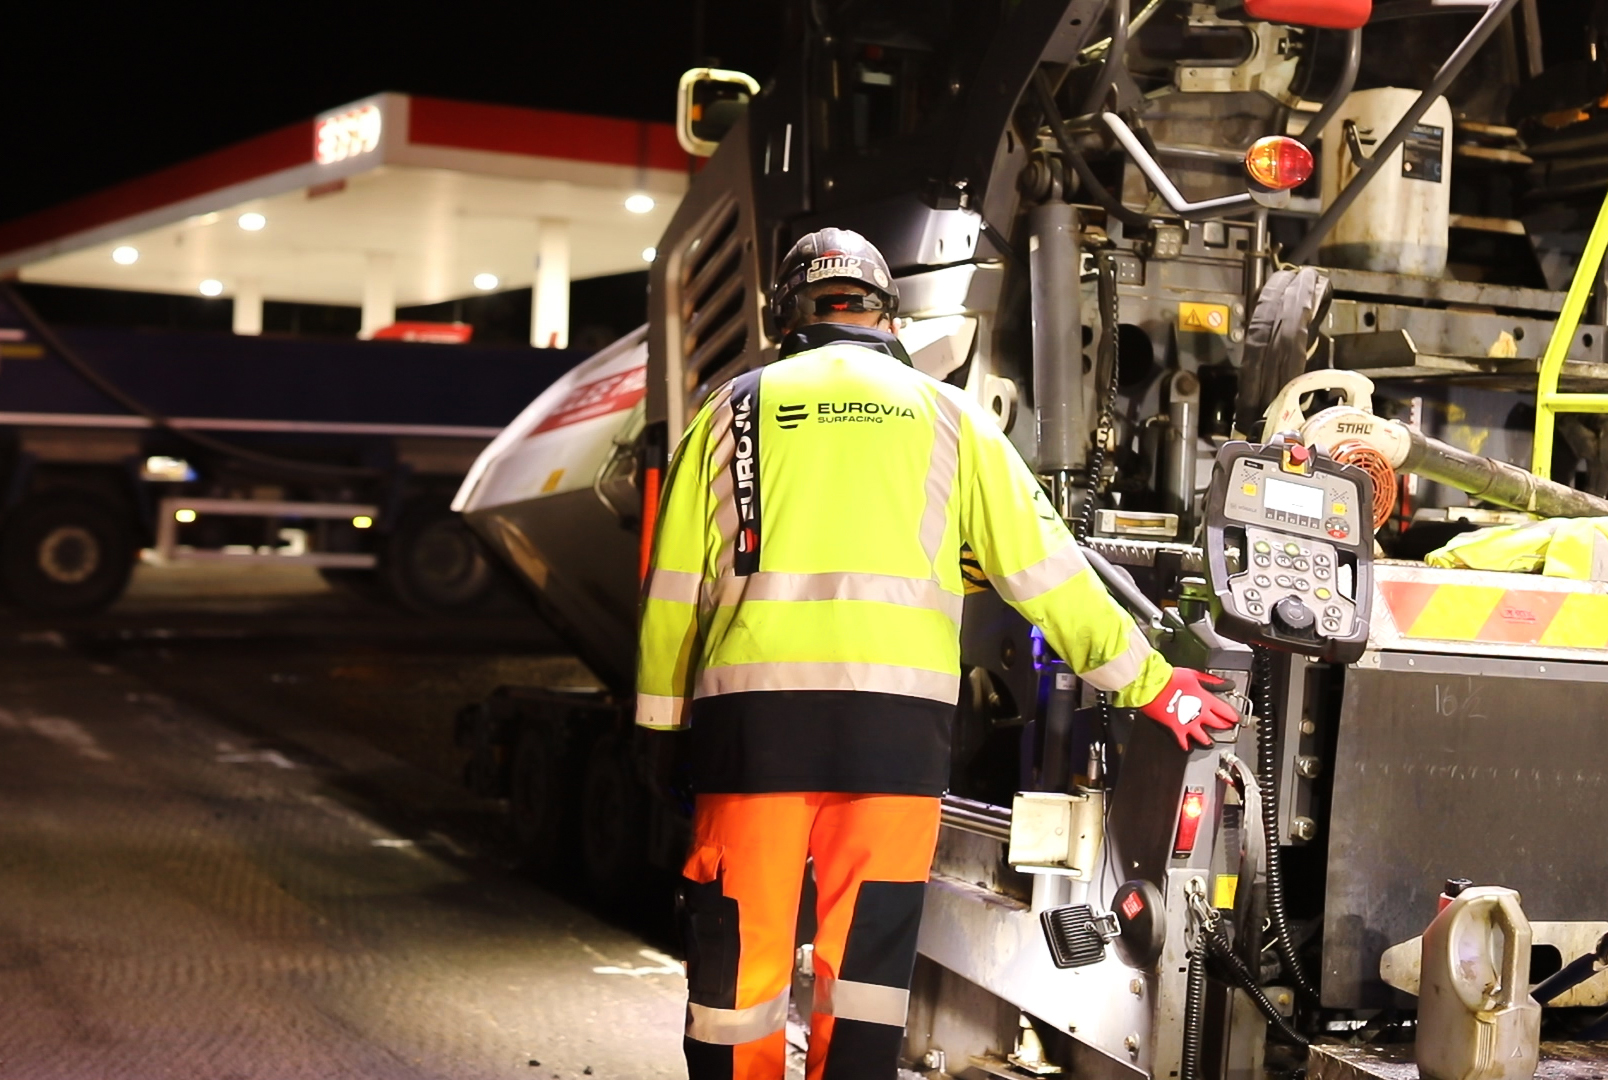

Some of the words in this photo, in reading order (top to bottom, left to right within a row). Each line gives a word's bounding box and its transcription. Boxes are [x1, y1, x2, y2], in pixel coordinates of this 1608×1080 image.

[810, 257, 859, 273] JMP
[818, 402, 916, 420] EUROVIA
[818, 415, 883, 424] SURFACING
[1336, 422, 1371, 435] STIHL
[1435, 684, 1459, 717] 16
